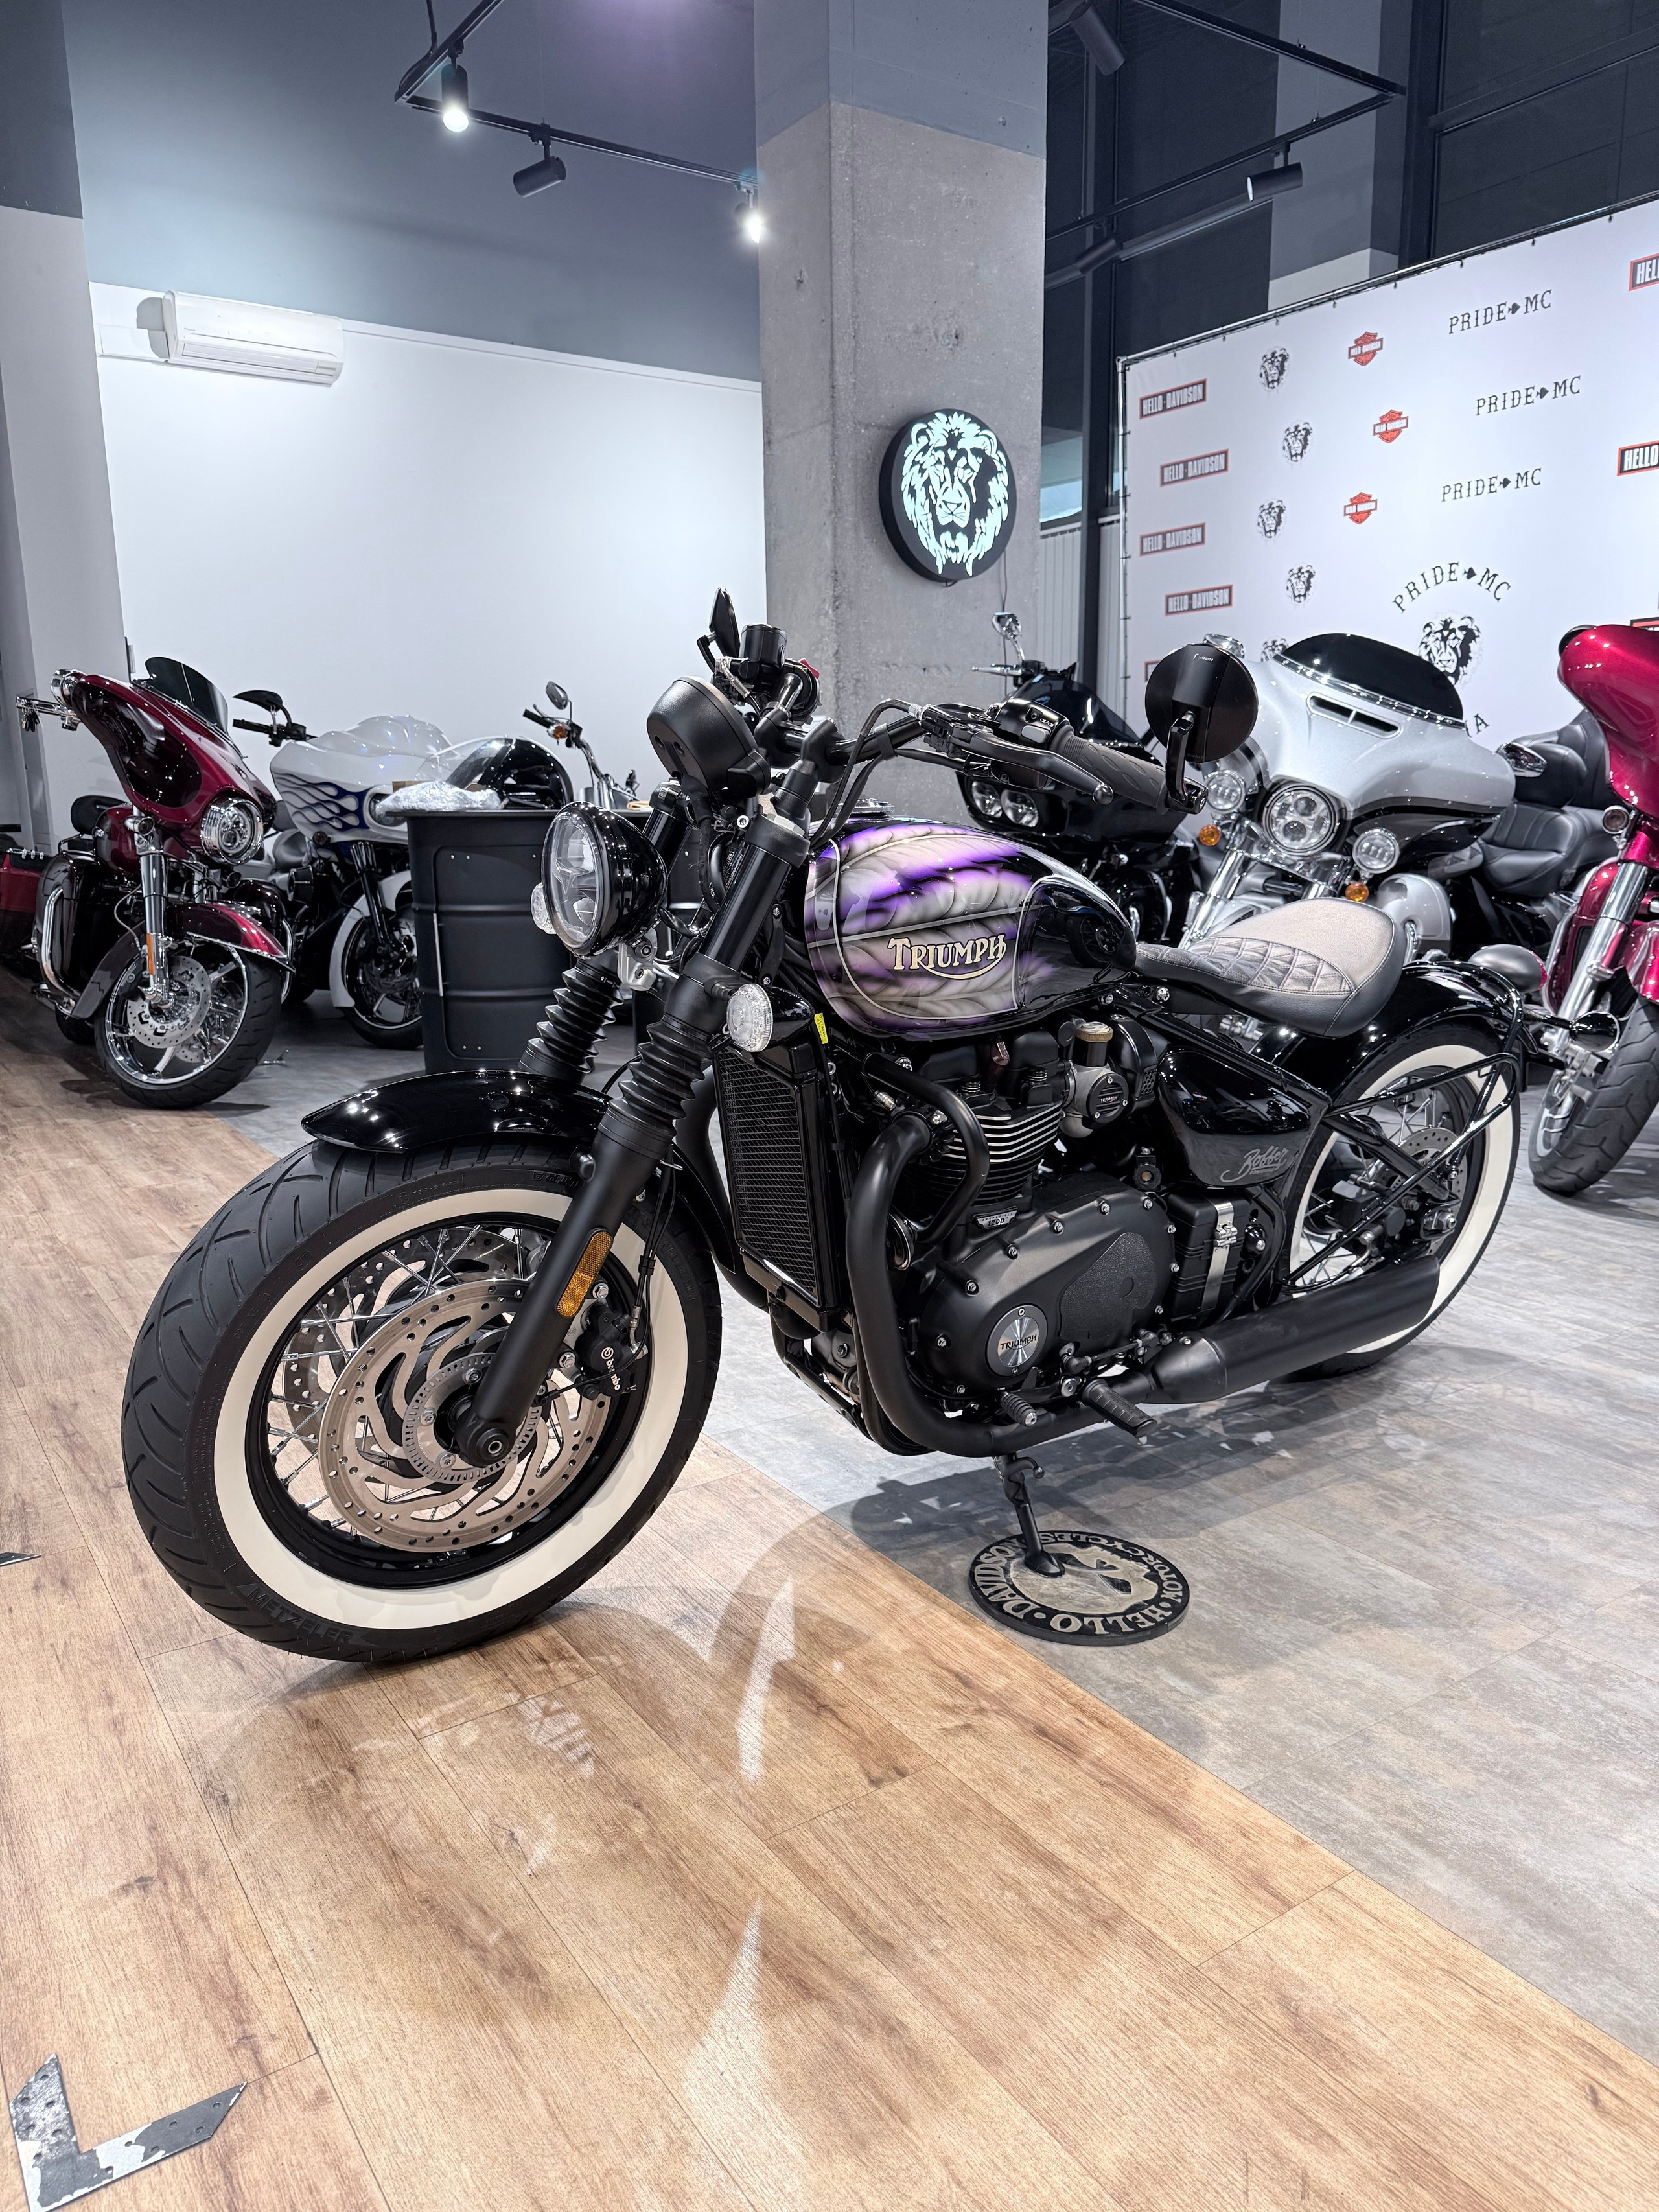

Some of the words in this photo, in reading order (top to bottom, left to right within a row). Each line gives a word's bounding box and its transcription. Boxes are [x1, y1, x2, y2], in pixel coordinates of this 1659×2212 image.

[1636, 257, 1659, 284] HEL
[1449, 301, 1507, 334] PRIDE
[1524, 288, 1552, 314] MC
[1143, 395, 1163, 415] HELLO
[1166, 383, 1203, 409] DAVIDSON
[1476, 385, 1535, 416] PRIDE
[1552, 375, 1581, 399] MC
[1163, 463, 1184, 483] HELLO
[1187, 453, 1225, 478] DAVIDSON
[1623, 445, 1659, 471] HELLO
[1441, 475, 1498, 502] PRIDE
[1514, 467, 1542, 489] MC
[1143, 534, 1163, 553] HELLO
[1166, 526, 1203, 549] DAVIDSON
[1168, 594, 1189, 613] HELLO
[1192, 588, 1230, 609] DAVIDSON
[1392, 561, 1459, 613] PRIDE
[1477, 567, 1512, 602] MC
[887, 934, 1007, 980] TRIUMPH
[1220, 1145, 1290, 1183] Bobber
[988, 1218, 1005, 1226] 1200
[1000, 1334, 1037, 1350] TRIUMPH
[1039, 1532, 1183, 1603] MOTORCYCLES
[247, 1587, 354, 1644] METZELER
[1050, 1604, 1172, 1635] HELLO
